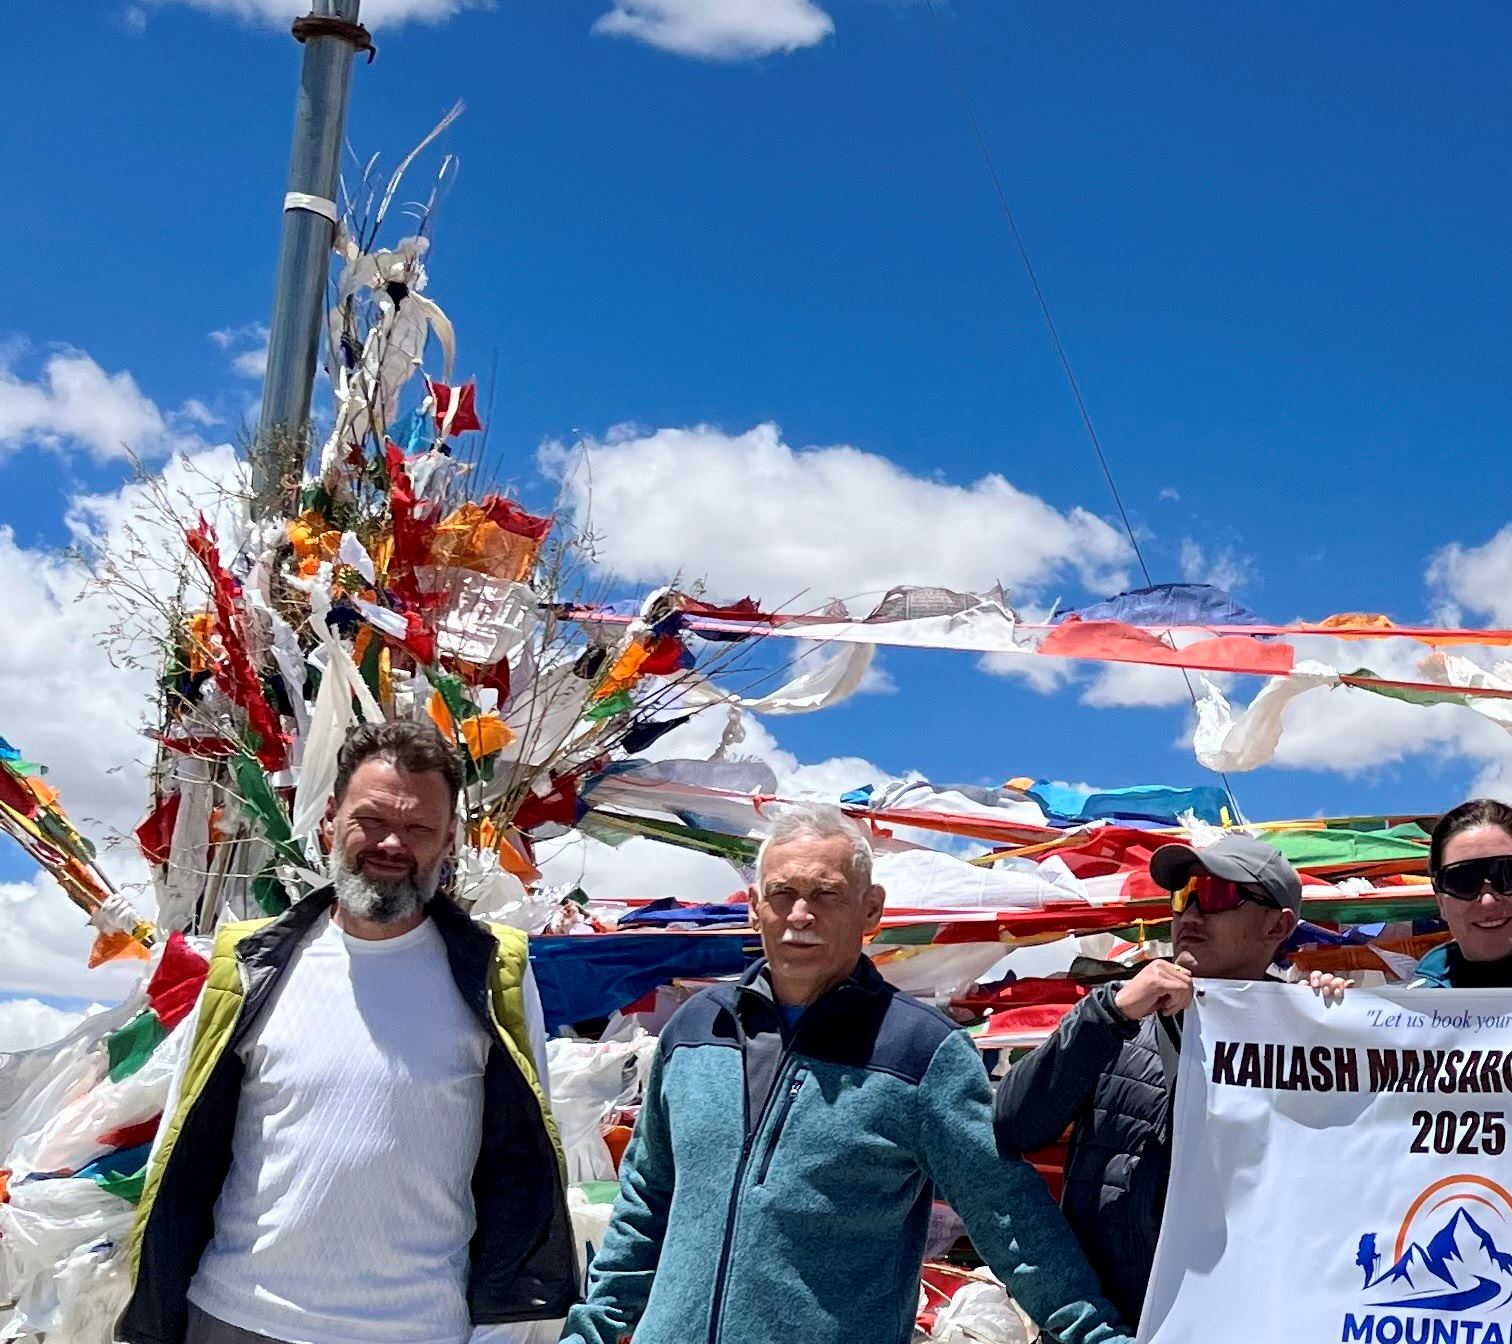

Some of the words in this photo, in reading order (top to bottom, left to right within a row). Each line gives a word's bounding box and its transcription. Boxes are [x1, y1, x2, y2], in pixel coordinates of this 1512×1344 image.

[1406, 1015, 1424, 1028] us
[1431, 1009, 1471, 1029] book
[1211, 1041, 1359, 1092] KAILASH
[1410, 1110, 1506, 1156] 2025
